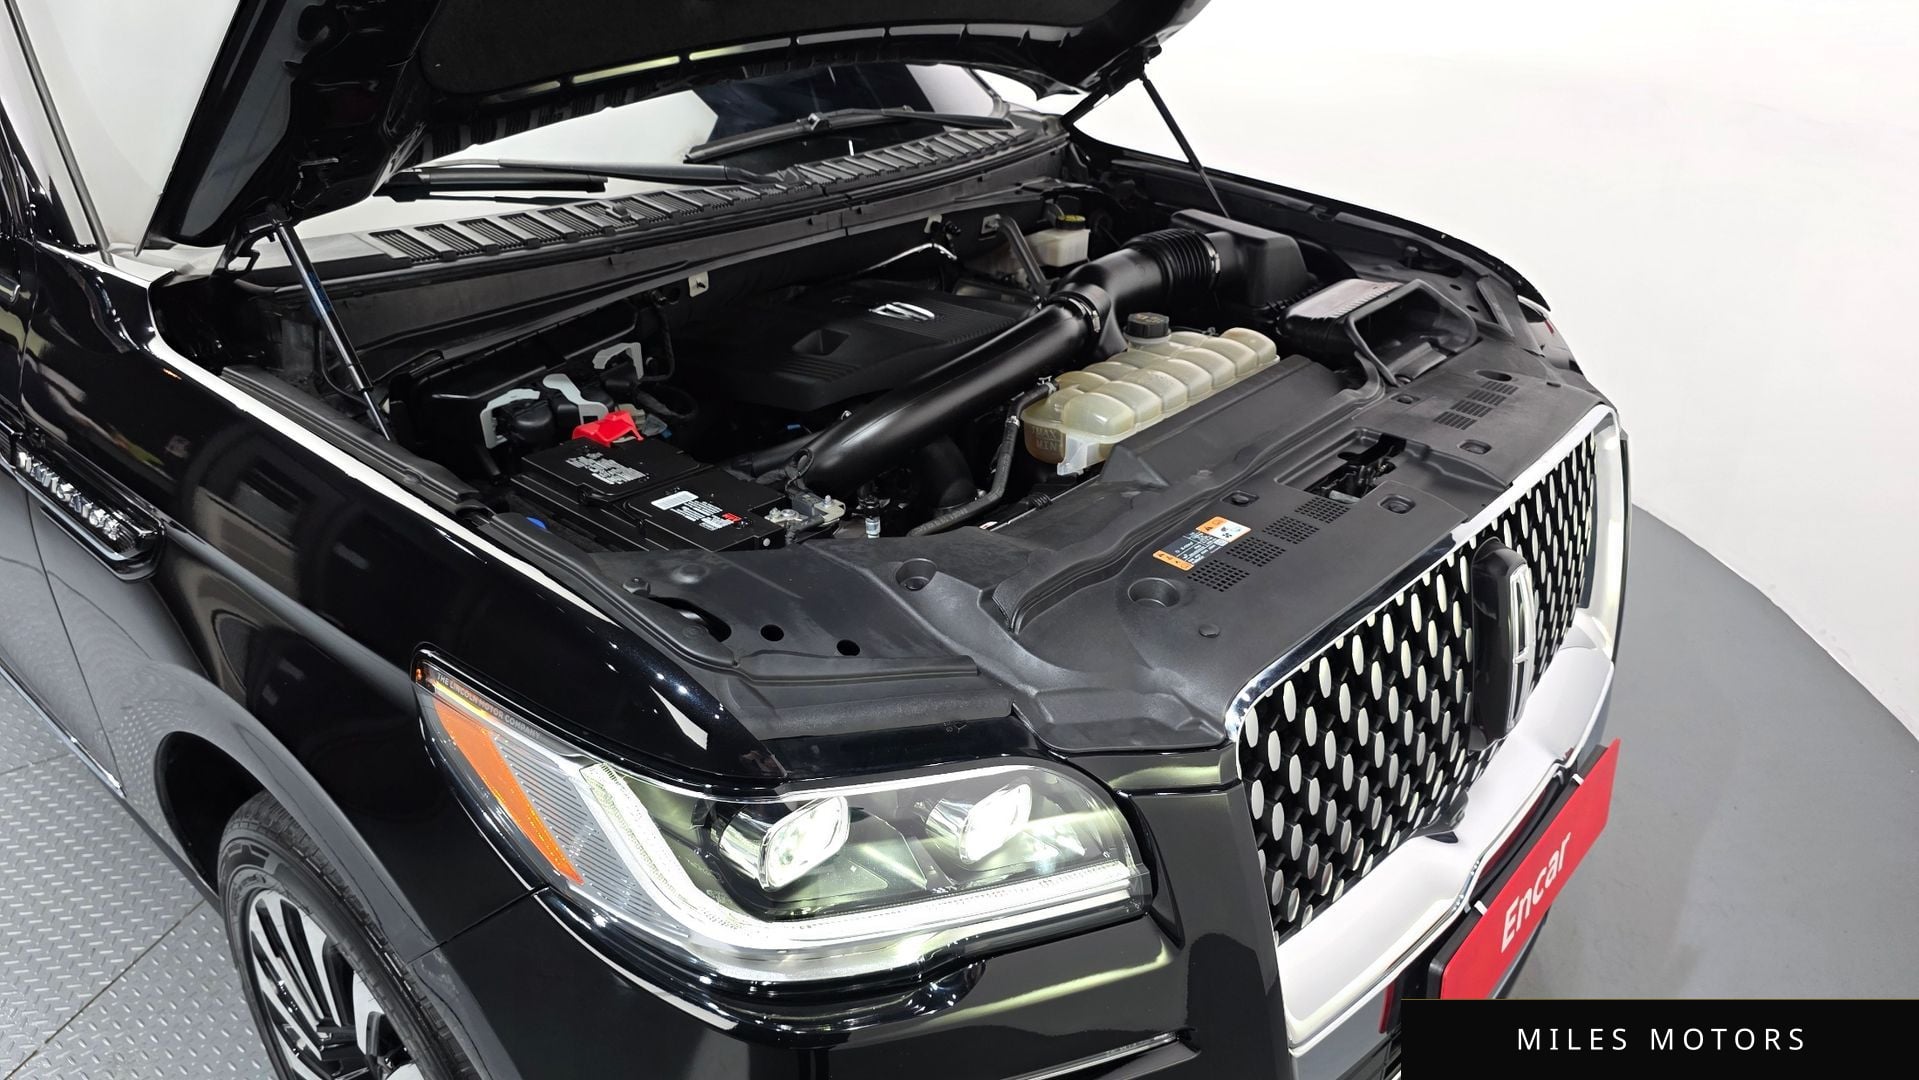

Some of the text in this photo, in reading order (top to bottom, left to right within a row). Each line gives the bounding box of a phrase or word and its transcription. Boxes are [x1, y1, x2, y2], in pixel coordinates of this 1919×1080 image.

[437, 674, 541, 740] THE LINCOLN MOTOR COMPANY
[1501, 832, 1571, 953] Encar
